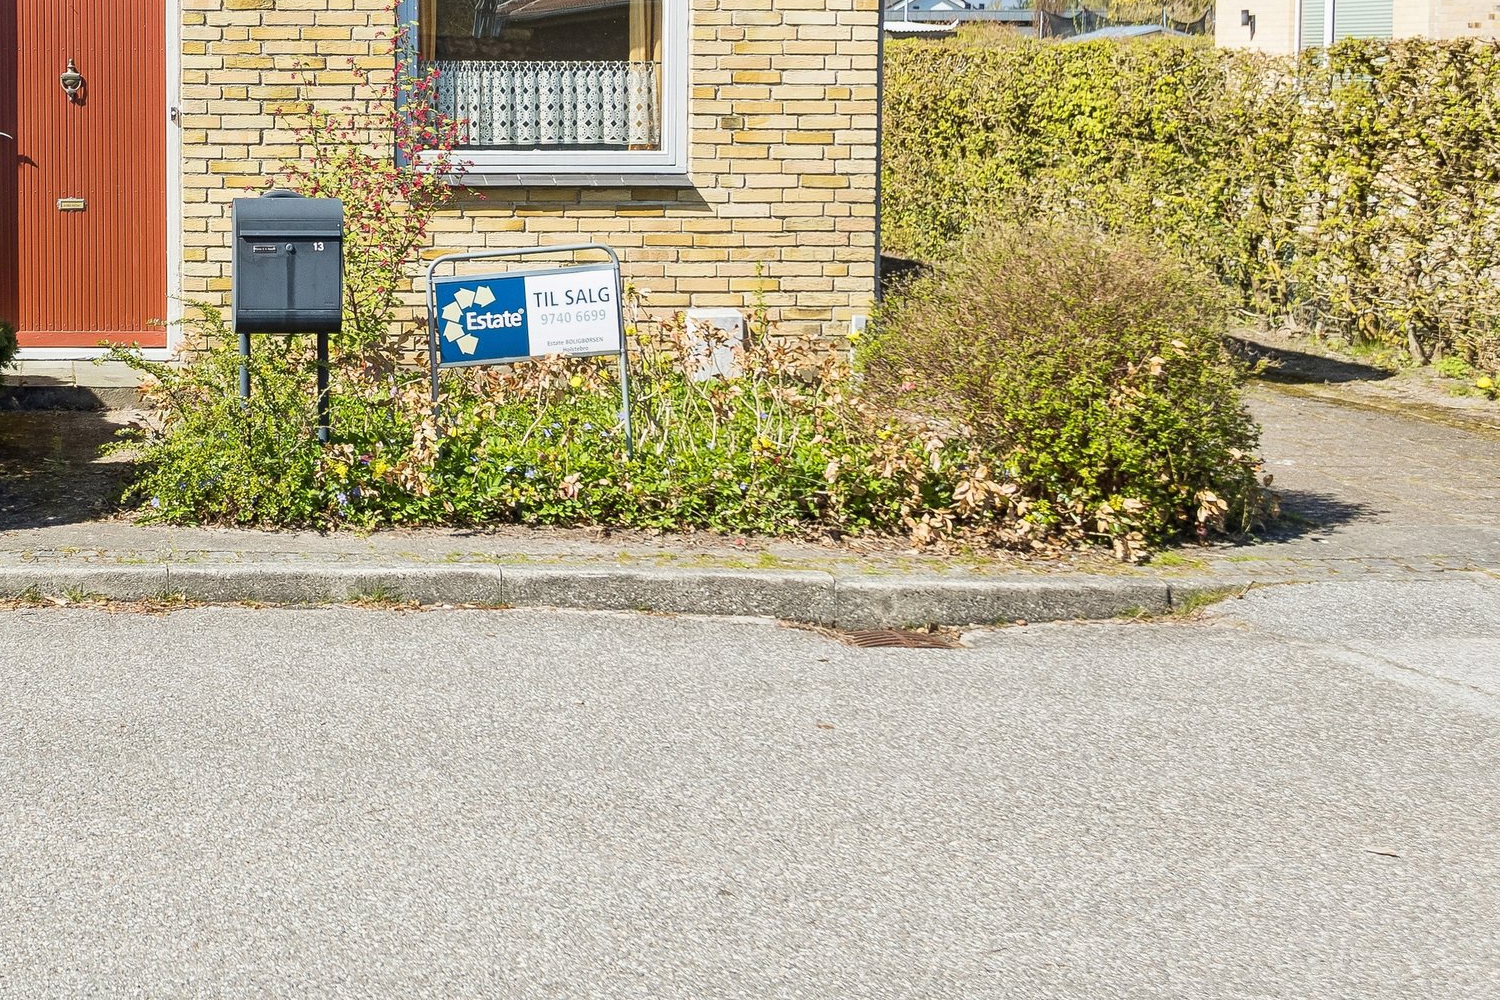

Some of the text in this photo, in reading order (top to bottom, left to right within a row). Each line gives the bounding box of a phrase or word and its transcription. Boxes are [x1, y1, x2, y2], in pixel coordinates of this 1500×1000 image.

[313, 241, 324, 251] 13
[533, 287, 610, 308] TIL SALG
[466, 310, 522, 331] Estate
[541, 309, 606, 325] 9740 6699
